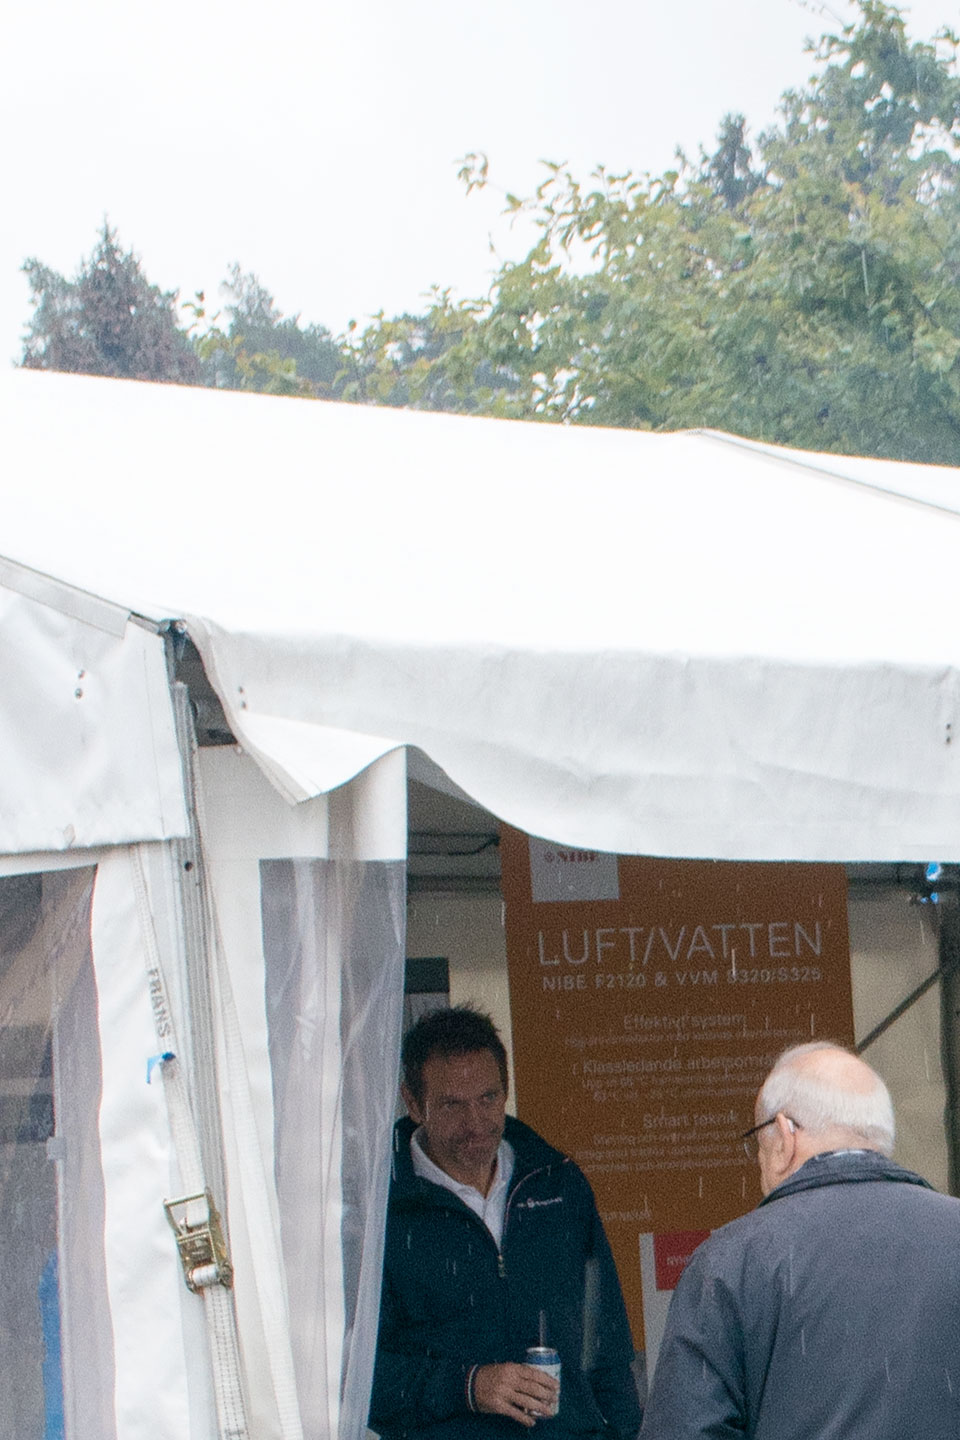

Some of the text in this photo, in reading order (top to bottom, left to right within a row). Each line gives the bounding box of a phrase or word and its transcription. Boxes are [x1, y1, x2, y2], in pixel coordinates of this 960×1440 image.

[538, 922, 822, 966] LUFT/VATTEN
[147, 967, 171, 1038] FRANS
[542, 975, 587, 991] NIBE
[595, 972, 646, 989] F2120
[654, 972, 668, 988] &
[675, 970, 718, 986] VVM
